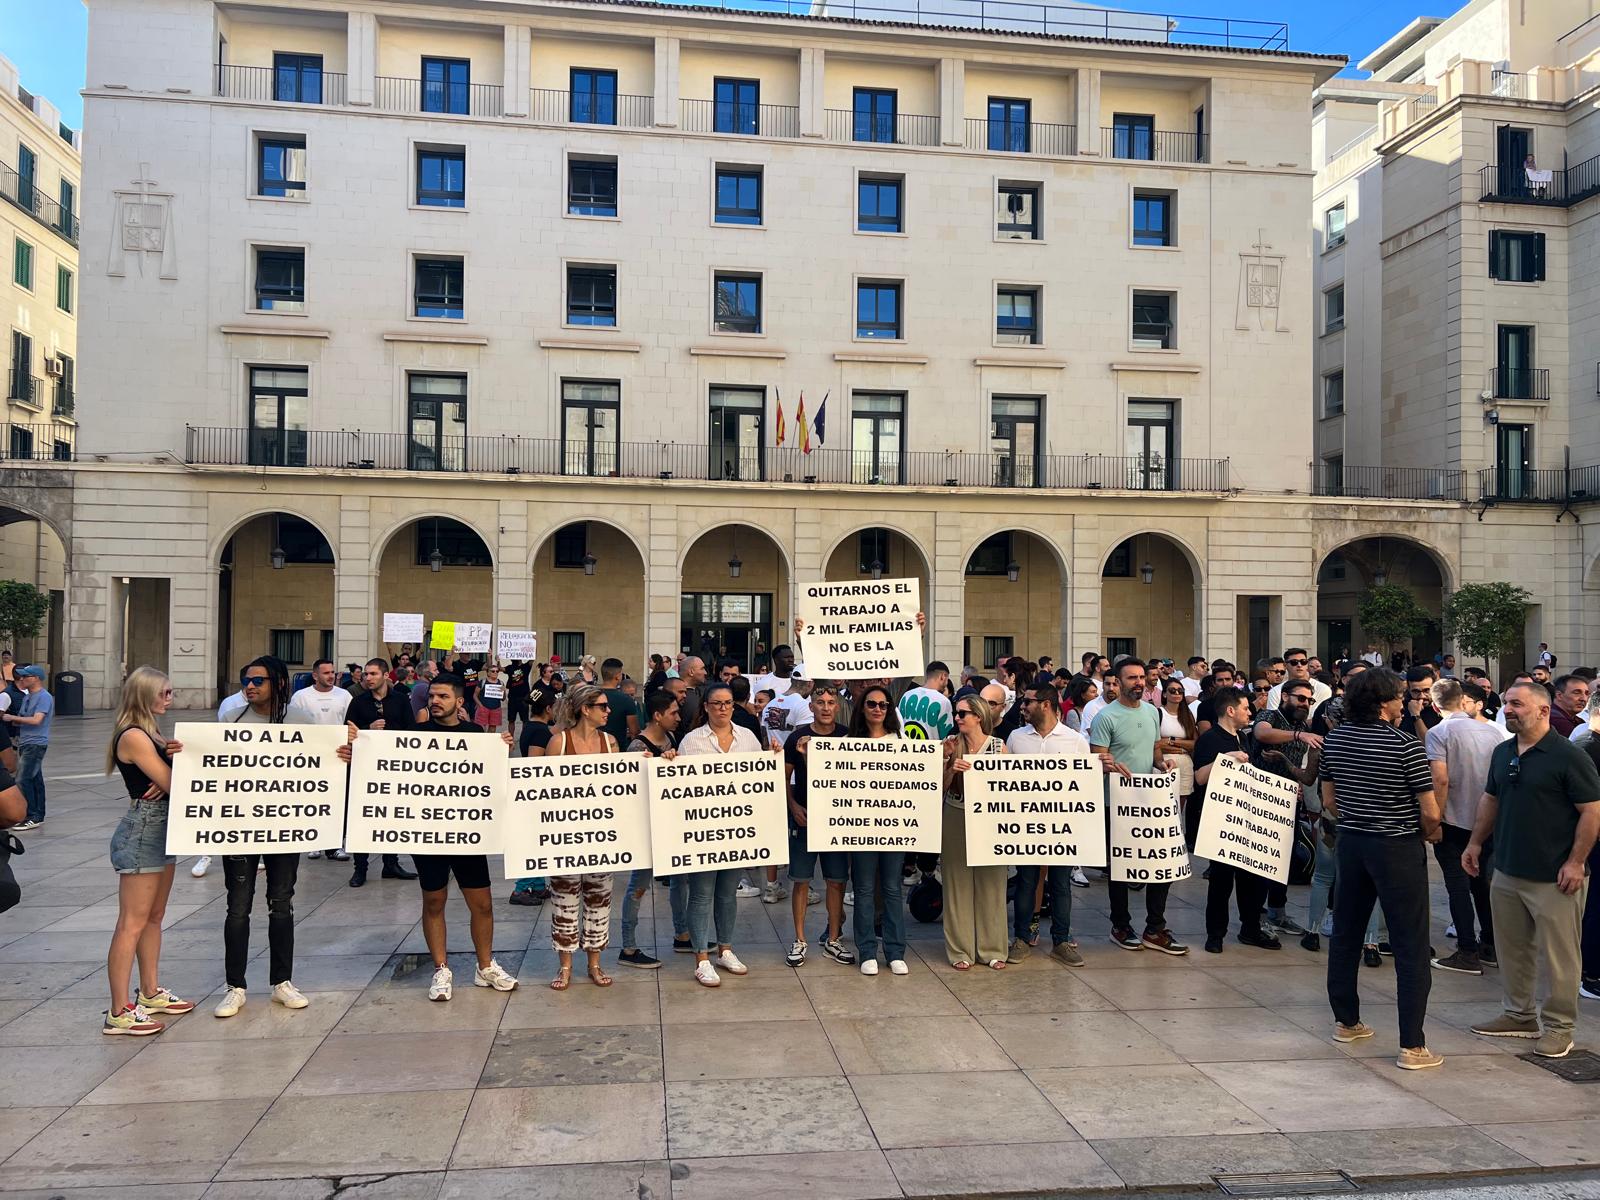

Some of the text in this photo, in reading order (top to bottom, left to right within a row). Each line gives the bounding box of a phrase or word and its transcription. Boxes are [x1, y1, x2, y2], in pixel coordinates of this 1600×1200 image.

[808, 584, 911, 597] QUITARNOS EL
[820, 604, 900, 616] TRABAJO A
[808, 621, 913, 634] 2 MIL FAMILIAS
[499, 640, 512, 648] NO
[830, 641, 894, 652] NO ES LA
[828, 658, 898, 670] SOLUCIÓN
[224, 730, 303, 743] NO A LA
[396, 737, 468, 750] NO A LA
[816, 742, 935, 754] SR. ALCALDE, A LAS
[203, 753, 320, 768] REDUCCIÓN
[378, 760, 483, 774] REDUCCIÓN
[825, 761, 924, 771] 2 MIL PERSONAS
[974, 759, 1092, 771] QUITARNOS EL
[511, 760, 639, 778] ESTA DECISIÓN
[657, 758, 776, 777] ESTA DECISIÓN
[1120, 776, 1170, 788] MENOS
[1221, 759, 1298, 794] SR. ALCALDE, A LAS
[191, 780, 328, 792] DE HORARIOS
[367, 782, 490, 797] DE HORARIOS
[661, 782, 774, 800] ACABARÁ CON
[812, 780, 937, 790] QUE NOS QUEDAMOS
[988, 781, 1079, 791] TRABAJO A
[515, 784, 636, 801] ACABARÁ CON
[1224, 778, 1291, 808] 2 MIL PERSONAS
[832, 799, 915, 810] SIN TRABAJO,
[974, 802, 1095, 813] 2 MIL FAMILIAS
[1210, 792, 1294, 828] QUE NOS QUEDAMOS
[185, 805, 330, 818] EN EL SECTOR
[363, 806, 492, 820] EN EL SECTOR
[541, 808, 614, 822] MUCHOS
[685, 805, 753, 820] MUCHOS
[1118, 806, 1170, 818] MENOS
[830, 816, 918, 827] DÓNDE NOS VA
[1226, 814, 1280, 842] SIN TRABAJO,
[684, 827, 756, 843] PUESTOS
[998, 824, 1072, 834] NO ES LA
[1131, 826, 1180, 838] CON EL
[196, 829, 318, 843] HOSTELERO
[372, 830, 480, 844] HOSTELERO
[540, 830, 617, 846] PUESTOS
[831, 837, 916, 846] A REUBICAR??
[994, 842, 1076, 855] SOLUCIÓN
[1220, 830, 1280, 858] DÓNDE NOS VA
[672, 848, 770, 867] DE TRABAJO
[1112, 847, 1132, 858] DE
[1138, 848, 1167, 859] LAS
[526, 852, 632, 870] DE TRABAJO
[1218, 849, 1278, 874] A REUBICAR??
[1127, 868, 1149, 880] NO
[1155, 869, 1172, 880] SE
